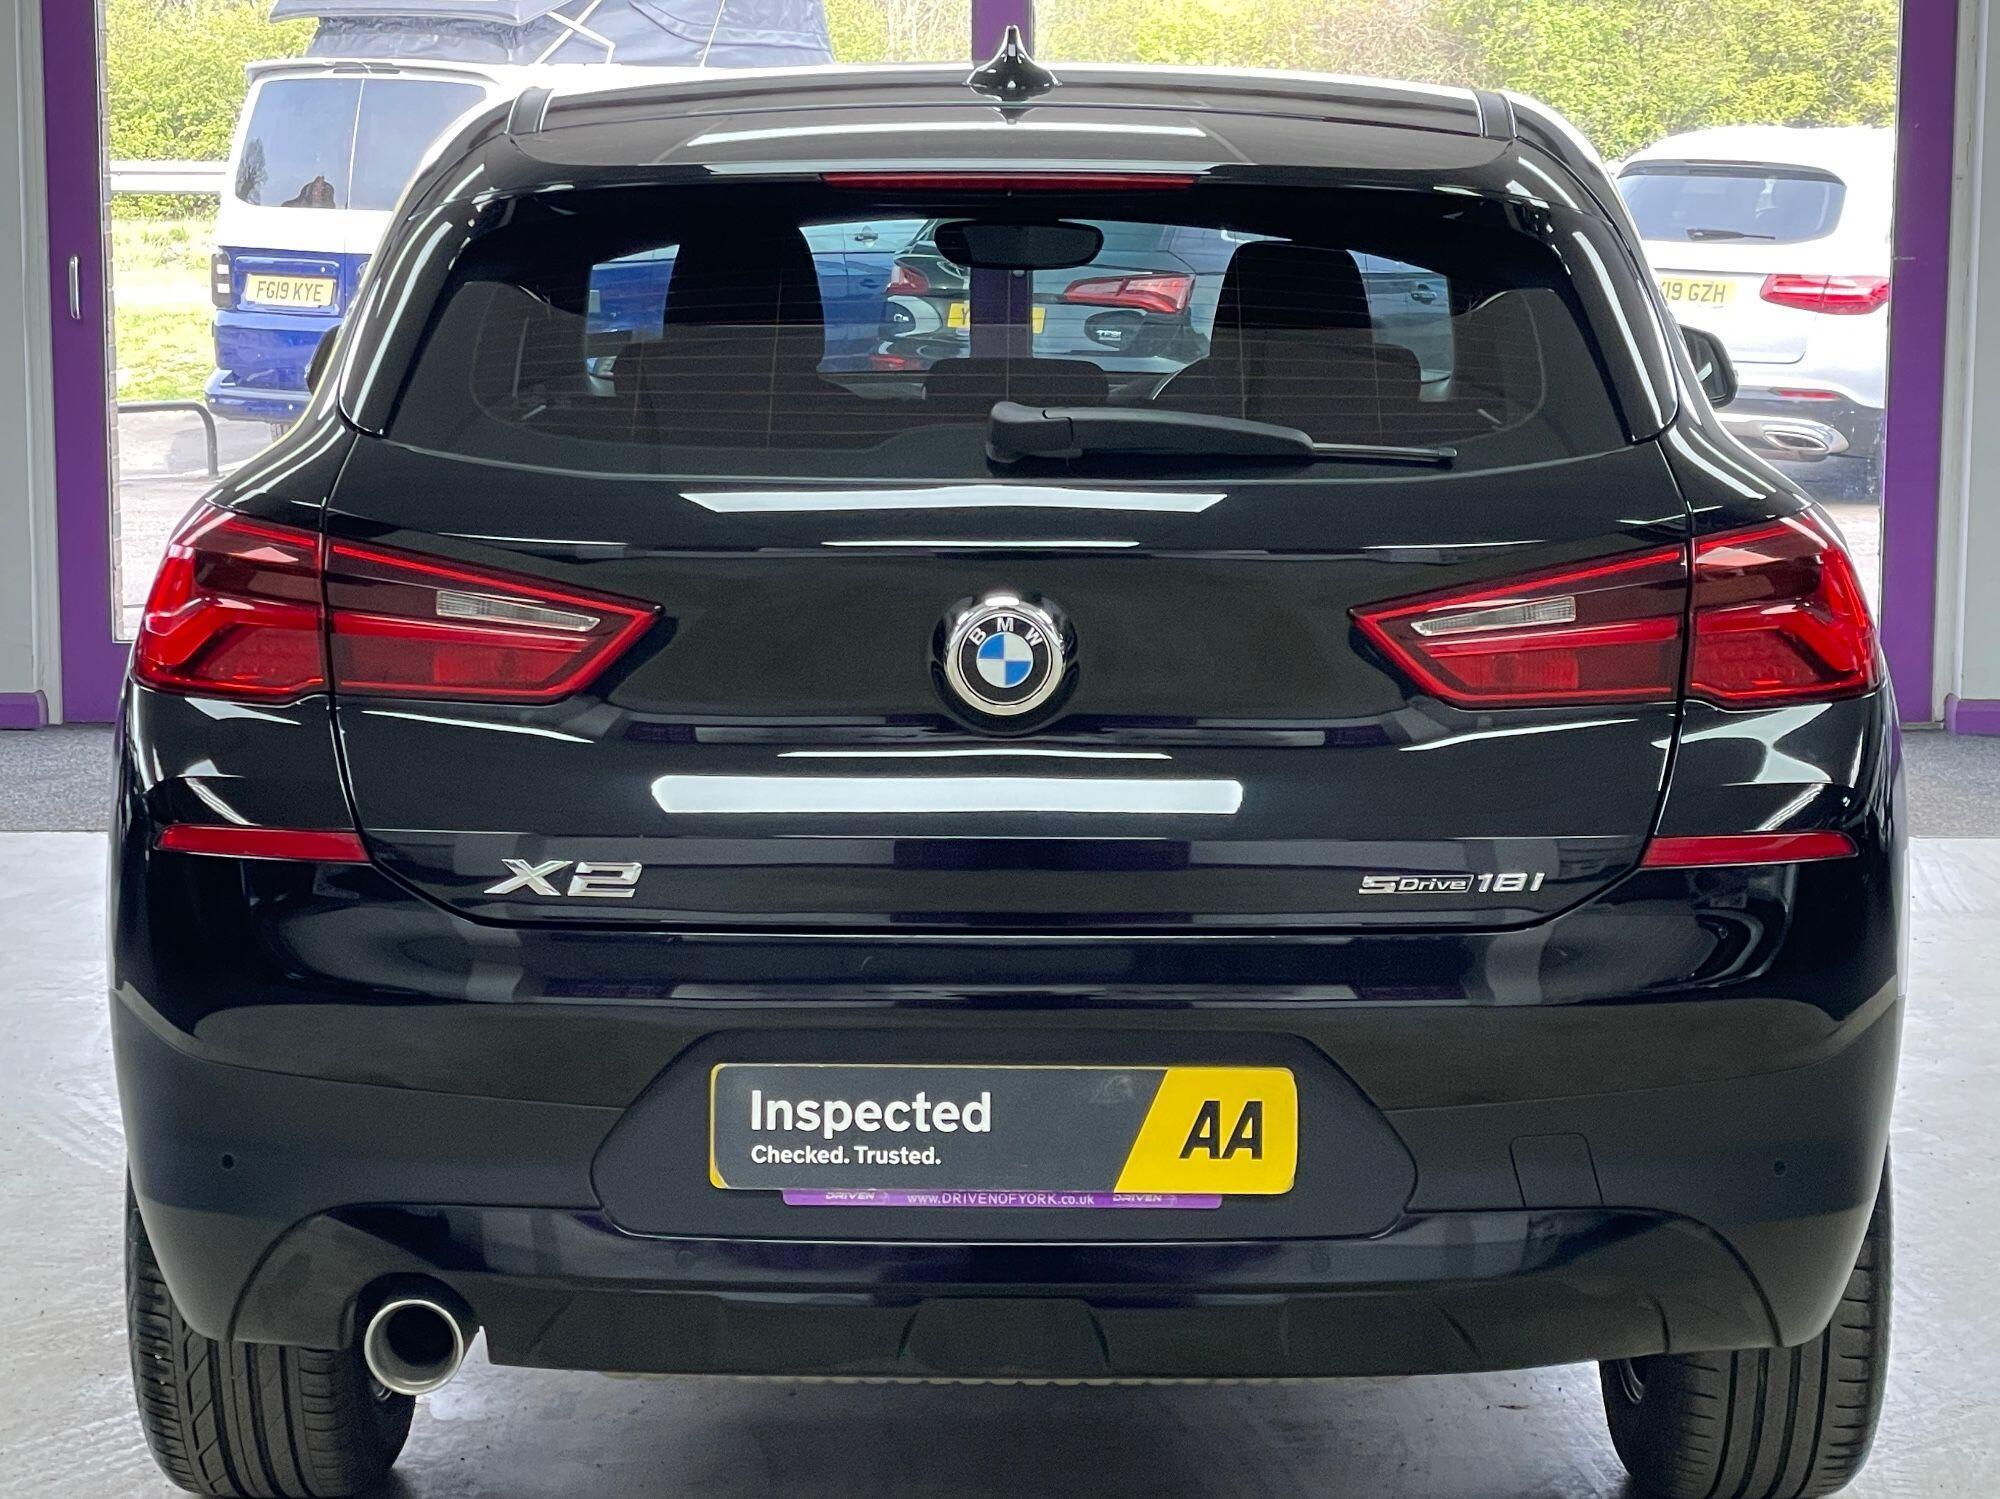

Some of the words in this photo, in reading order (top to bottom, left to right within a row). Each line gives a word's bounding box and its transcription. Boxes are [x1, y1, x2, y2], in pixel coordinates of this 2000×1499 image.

[256, 280, 290, 300] FG19
[292, 282, 324, 302] KYE
[1660, 281, 1683, 301] 19
[1688, 282, 1726, 303] GZH
[968, 617, 1043, 647] BMW
[483, 858, 643, 898] X2
[751, 1089, 992, 1140] Inspected
[1178, 1100, 1264, 1160] AA
[751, 1144, 851, 1165] Checked.
[853, 1145, 942, 1166] Trusted.
[825, 1191, 876, 1201] DRIVEN
[907, 1192, 1095, 1206] www.DRIVENOFYORK.co.uk
[1112, 1194, 1163, 1203] DRIVEN
